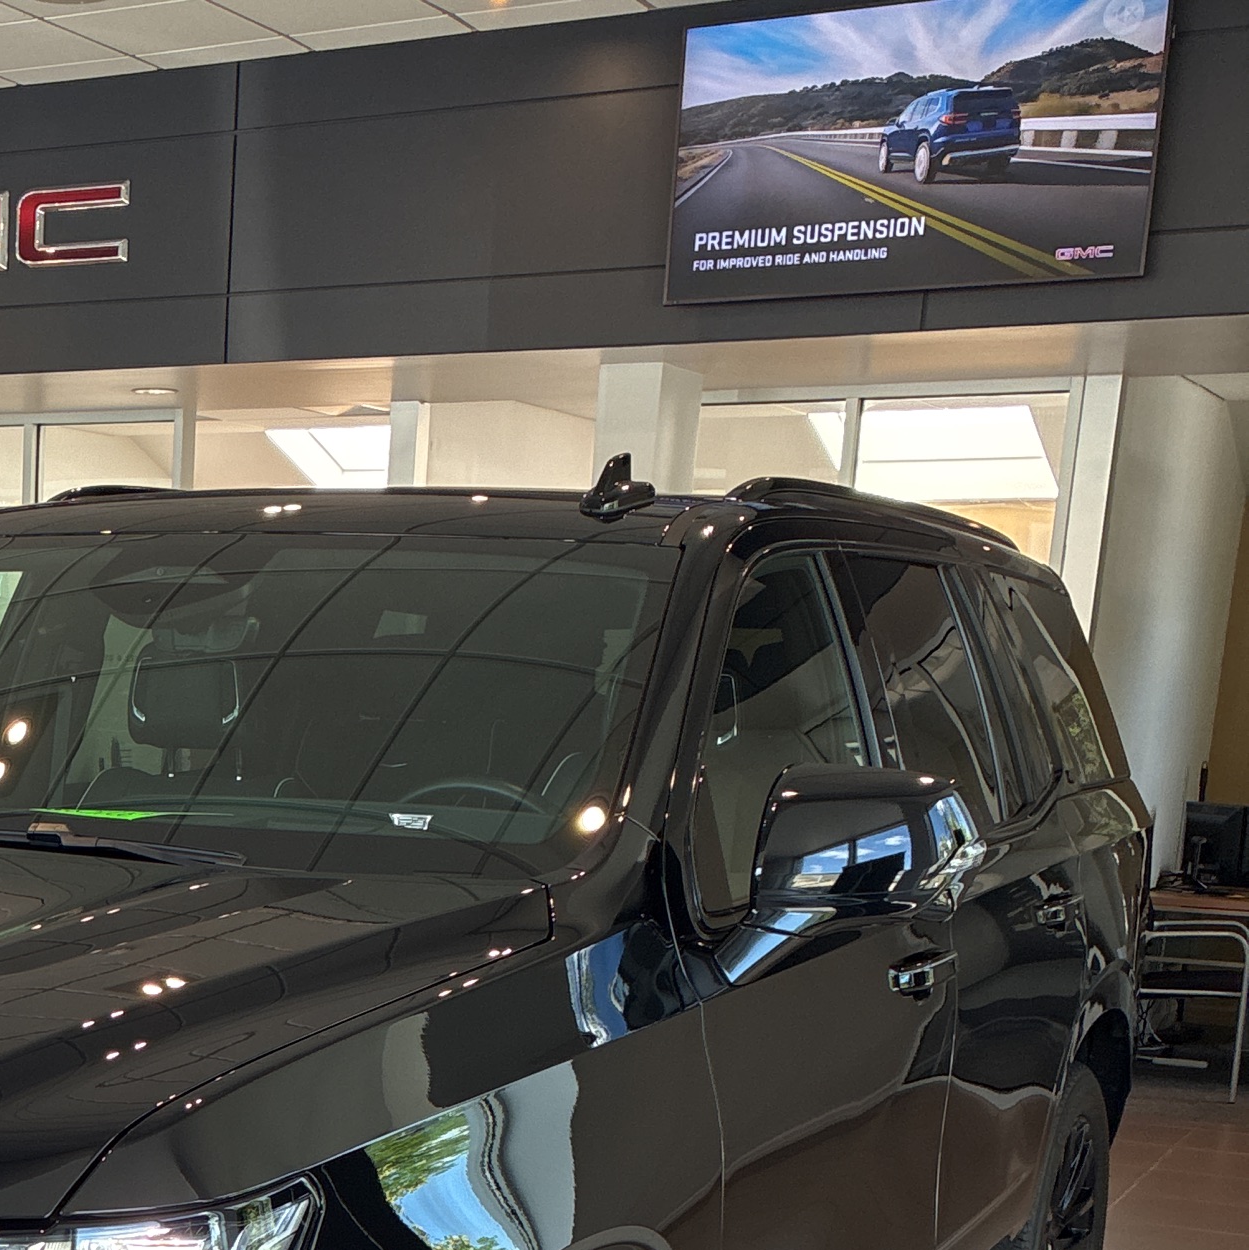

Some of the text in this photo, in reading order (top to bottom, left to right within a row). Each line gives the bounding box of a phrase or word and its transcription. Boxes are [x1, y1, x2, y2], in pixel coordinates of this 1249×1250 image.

[693, 216, 927, 252] PREMIUM SUSPENSION
[692, 246, 888, 272] FOR IMPROVED RIDE AND HANDLING
[1054, 244, 1115, 261] GMC
